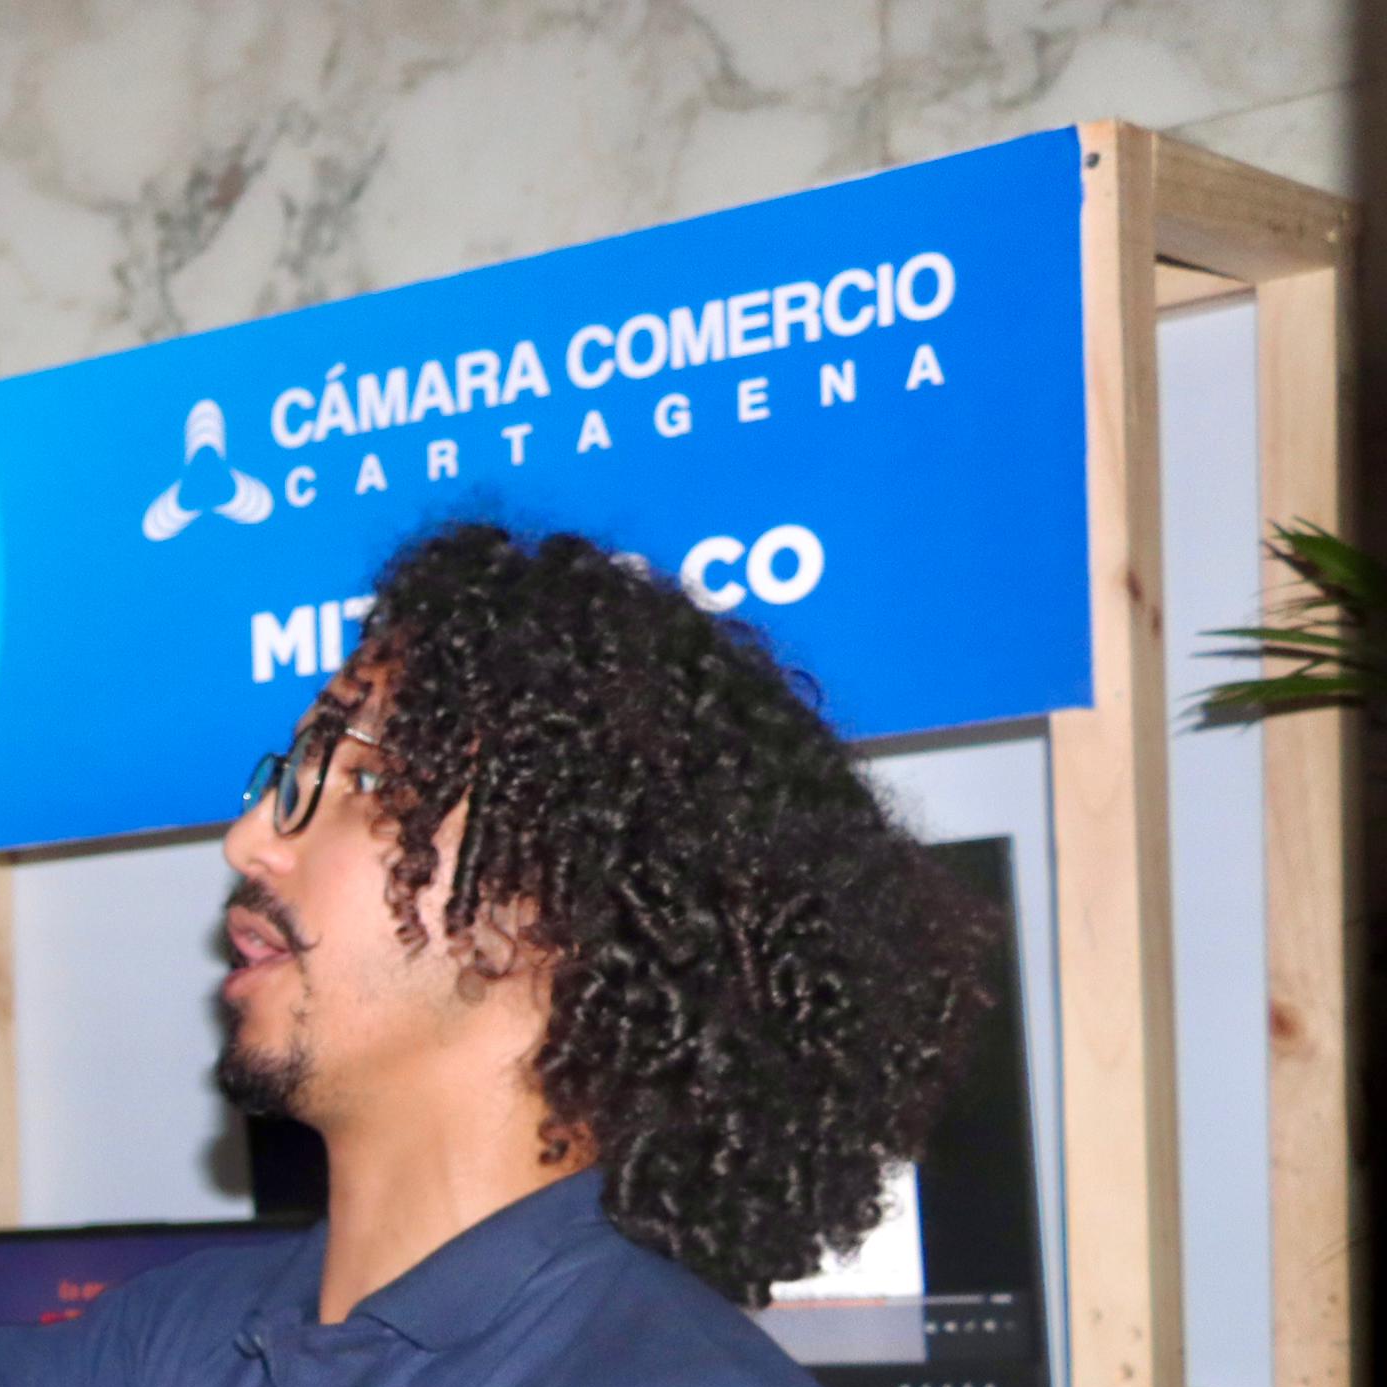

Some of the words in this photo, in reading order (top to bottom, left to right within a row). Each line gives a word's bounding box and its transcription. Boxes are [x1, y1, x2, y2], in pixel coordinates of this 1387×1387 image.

[271, 340, 550, 450] CÁMARA
[565, 252, 956, 390] COMERCIO
[284, 344, 945, 507] CARTAGENA
